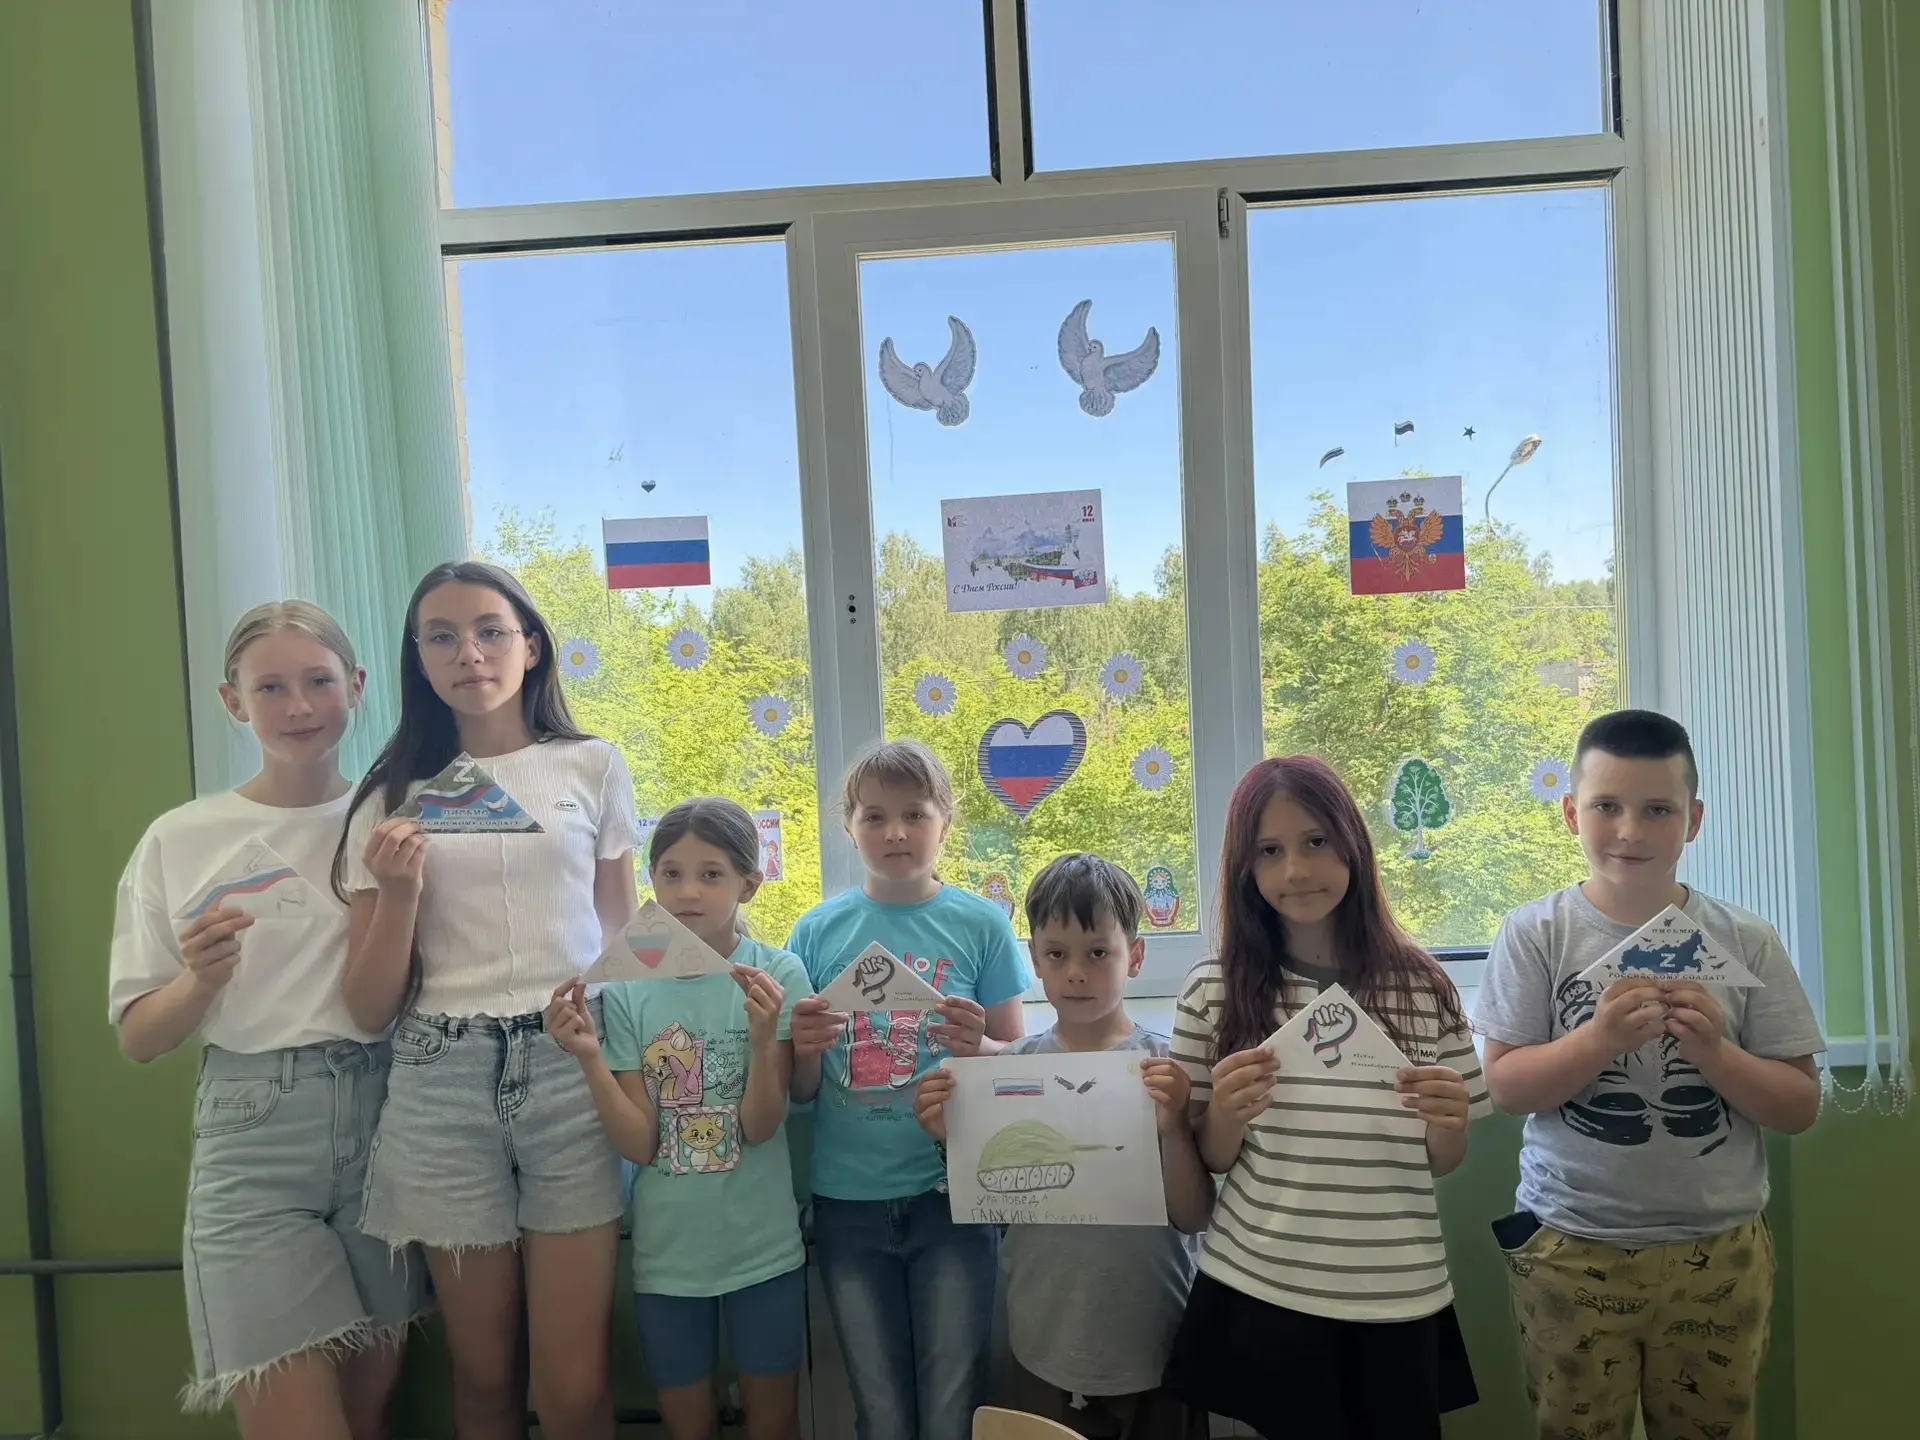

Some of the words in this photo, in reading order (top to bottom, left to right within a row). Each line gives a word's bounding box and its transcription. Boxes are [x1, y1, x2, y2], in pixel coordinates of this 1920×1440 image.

[1081, 504, 1094, 517] 12
[953, 584, 961, 595] С
[453, 761, 475, 783] Z
[1659, 952, 1676, 968] Z
[1608, 972, 1679, 980] РОССИЙСКОМУ
[977, 1194, 998, 1205] УРА
